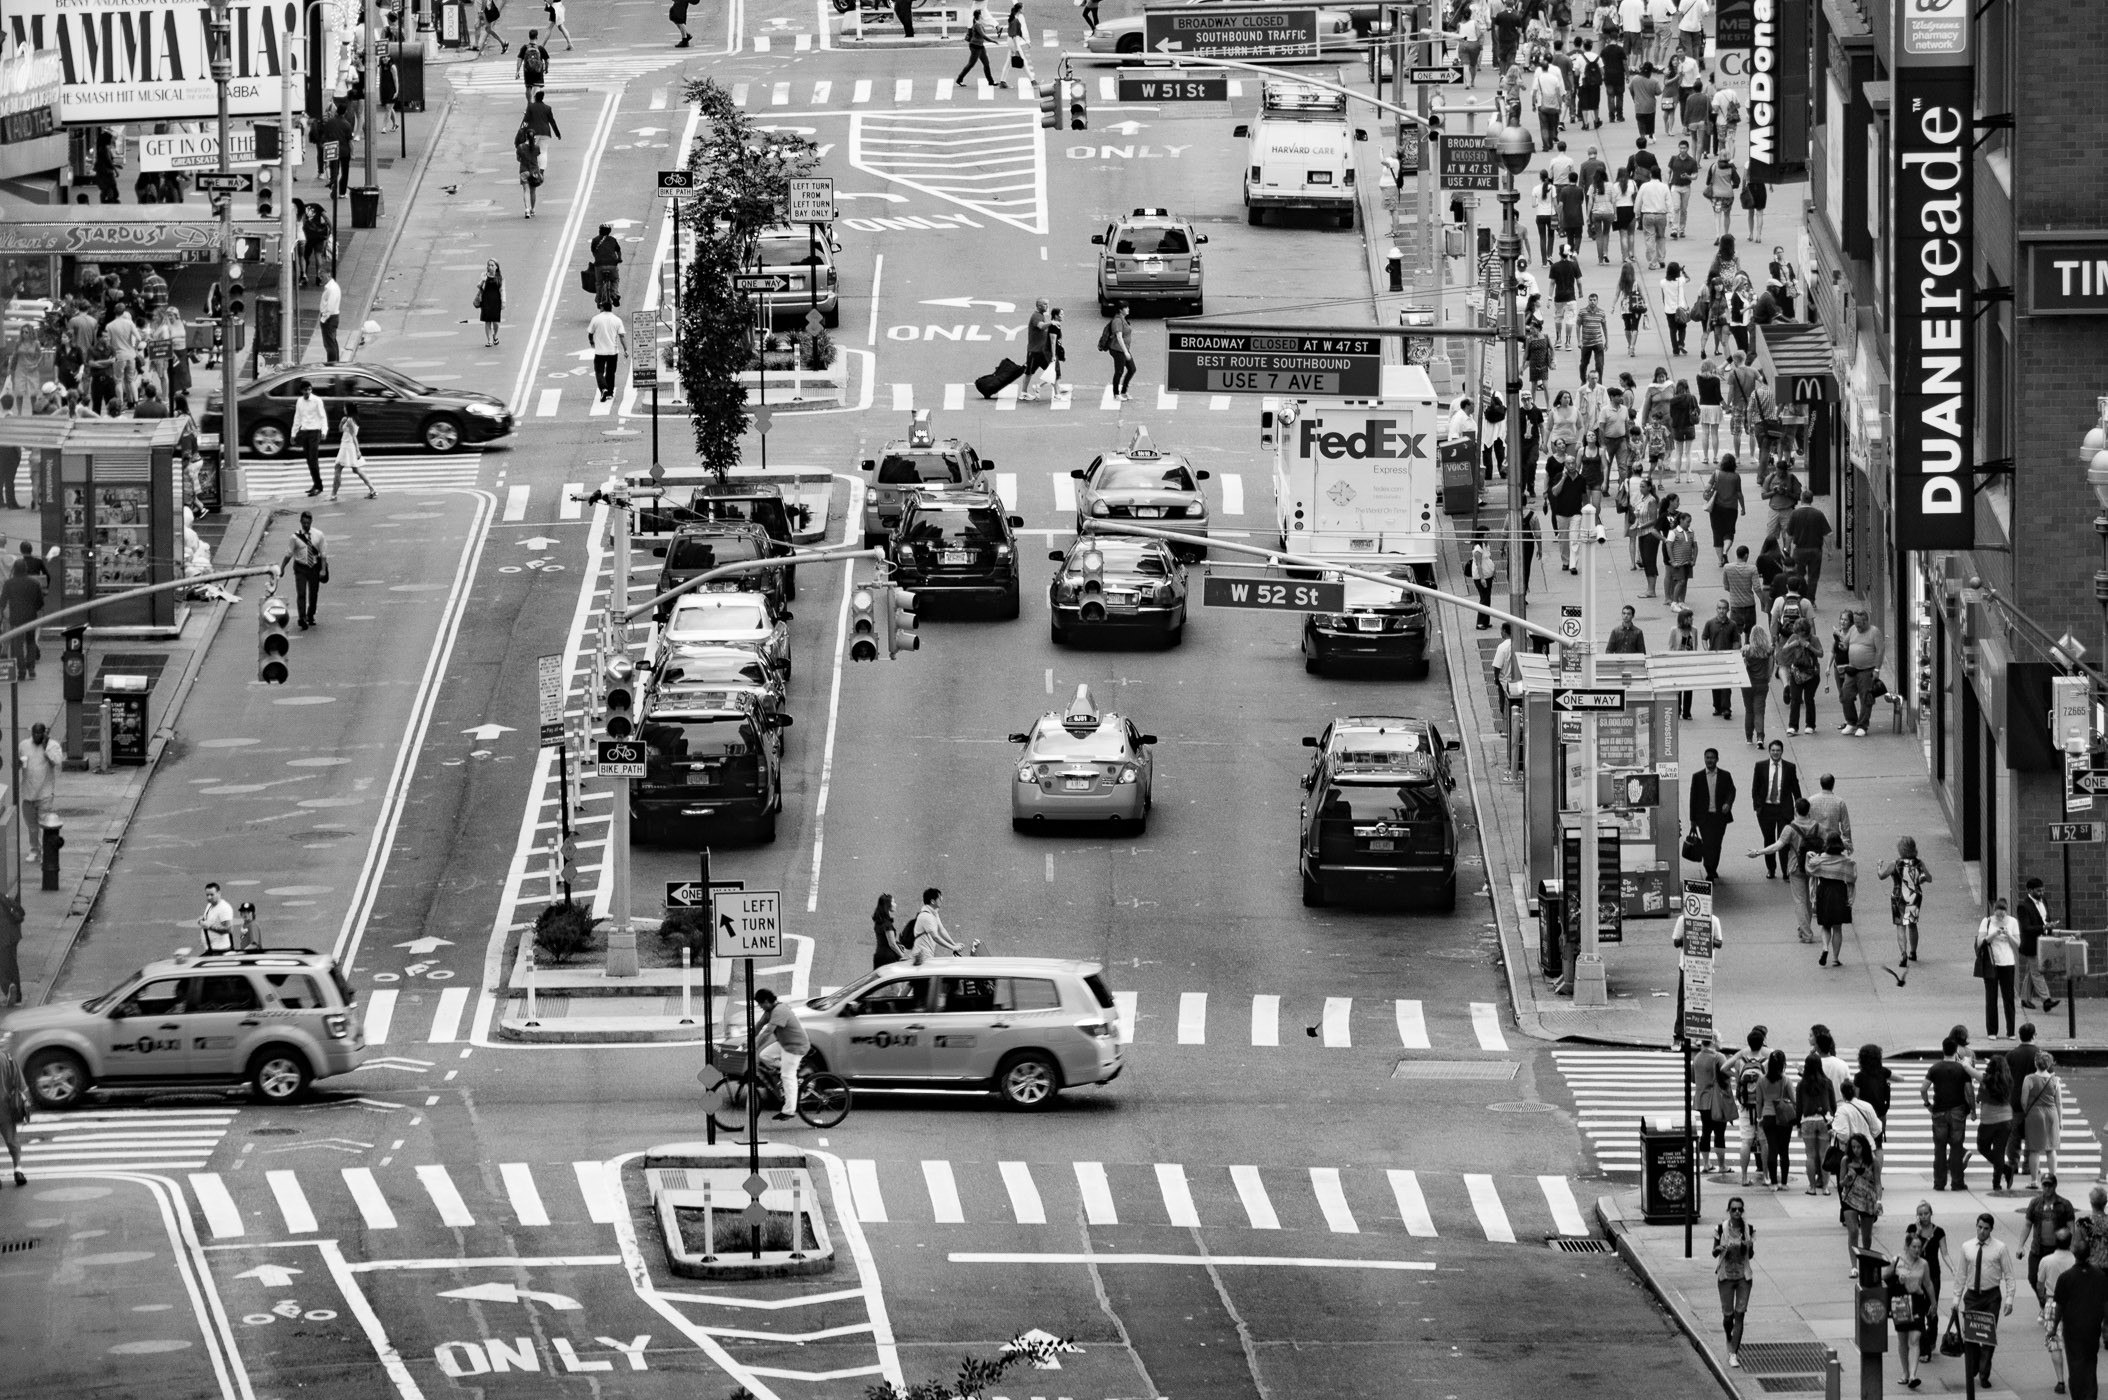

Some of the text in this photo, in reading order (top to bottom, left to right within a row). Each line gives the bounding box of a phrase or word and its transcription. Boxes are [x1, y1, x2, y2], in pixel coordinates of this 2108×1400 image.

[1178, 16, 1284, 29] BROADWAY CLOSED
[1195, 30, 1306, 42] SOUTHBOUND TRAFFIC
[1912, 31, 1959, 41] pharmacy
[8, 9, 186, 85] MAMMA
[1915, 40, 1953, 49] network
[1417, 72, 1456, 80] ONE WAY
[76, 91, 113, 104] SMASH
[117, 91, 134, 102] HIT
[138, 89, 184, 103] MUSICAL
[1142, 84, 1205, 97] W 51 St
[146, 139, 172, 156] GET
[181, 138, 195, 154] IN
[1271, 142, 1334, 155] HARVARD CARE
[1447, 138, 1486, 149] BROADWA
[1066, 145, 1192, 159] ONLY
[1454, 151, 1486, 161] CLOSED
[1447, 164, 1493, 174] AT W 47 ST
[1447, 177, 1492, 187] USE 7 AVE
[661, 188, 691, 196] BIKE PATH
[842, 213, 985, 232] ONLY
[0, 225, 167, 250] llen's STARDUST
[742, 280, 780, 288] ONE WAY
[887, 325, 1028, 341] ONLY
[1181, 337, 1369, 354] BROADWAY CLOSED AT W 47 ST
[1197, 356, 1351, 370] BEST ROUTE SOUTHBOUND
[1222, 372, 1323, 391] USE 7 AVE
[1300, 419, 1428, 460] FedEx
[1373, 464, 1408, 475] Express
[1231, 583, 1319, 606] W 52 St
[1564, 696, 1615, 705] ONE WAY
[2063, 706, 2086, 716] 72665
[1664, 707, 1673, 757] Newsstand
[600, 764, 643, 774] BIKE PATH
[2085, 777, 2107, 788] ONE
[2052, 824, 2088, 840] W 52 ST
[682, 889, 703, 900] ONE
[743, 899, 774, 912] LEFT
[742, 918, 775, 930] TURN
[742, 936, 776, 949] LANE
[1969, 1321, 1991, 1331] ANYTIME
[434, 1335, 652, 1378] ONLY
